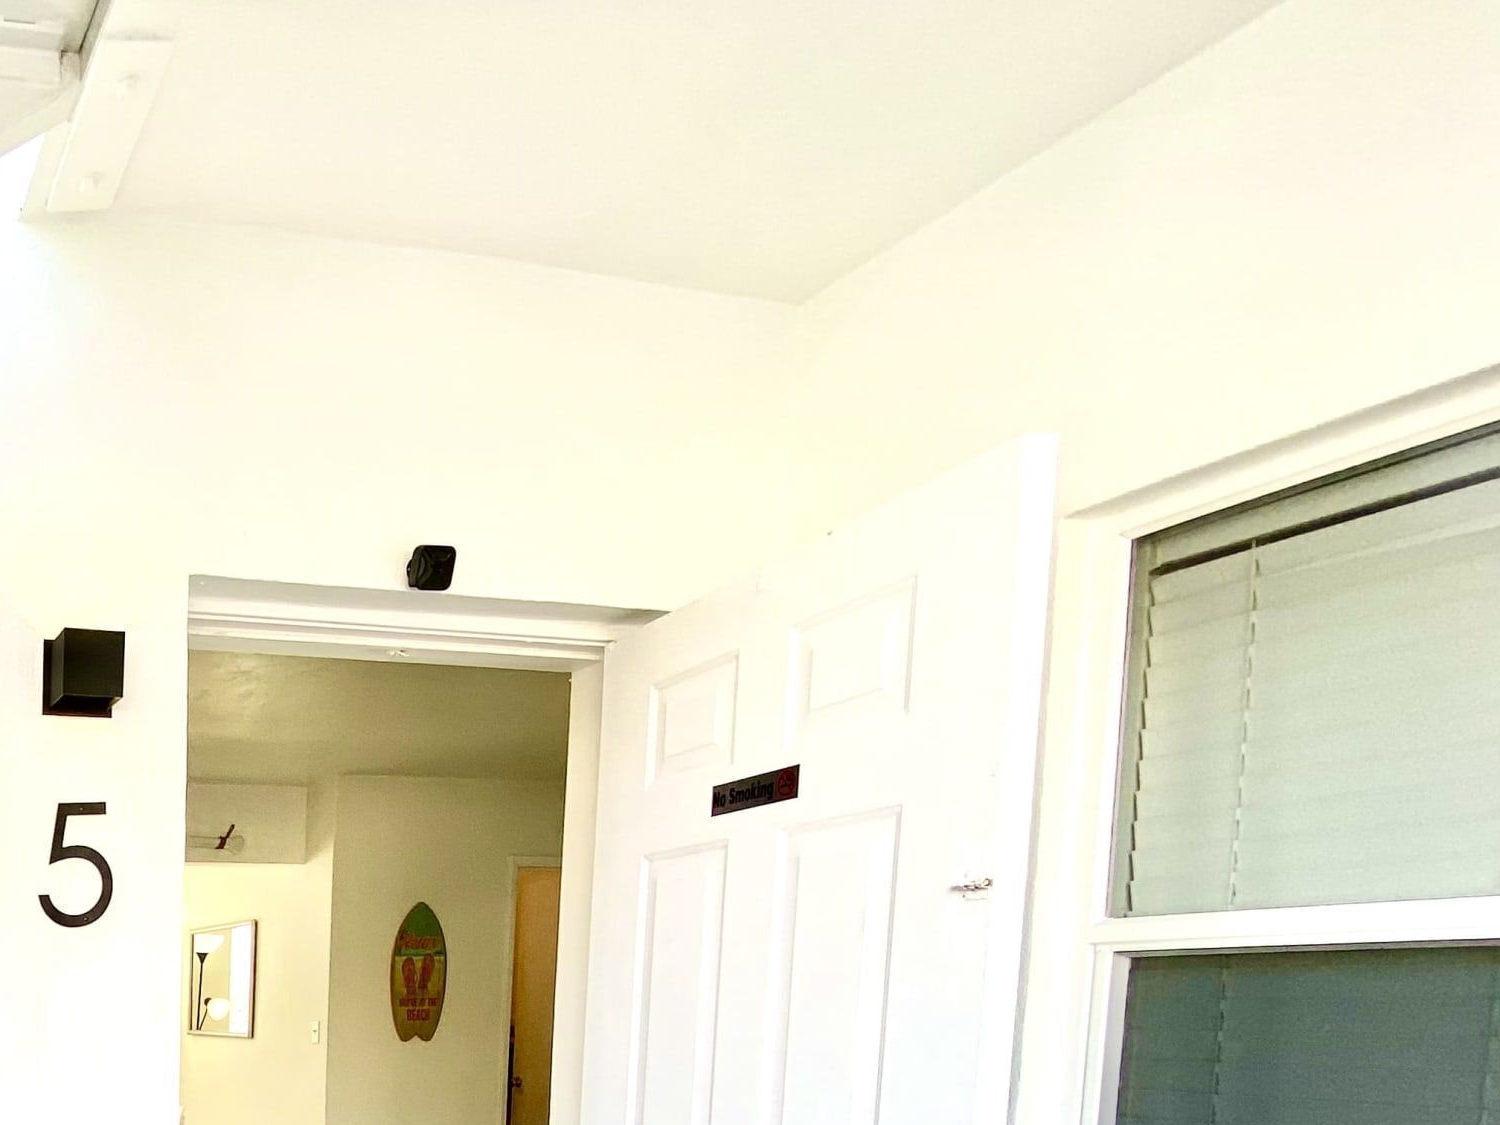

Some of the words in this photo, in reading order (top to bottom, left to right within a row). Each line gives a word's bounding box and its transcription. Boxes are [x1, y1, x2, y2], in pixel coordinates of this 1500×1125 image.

[712, 791, 726, 808] No
[729, 780, 775, 804] Smoking
[38, 802, 113, 928] 5
